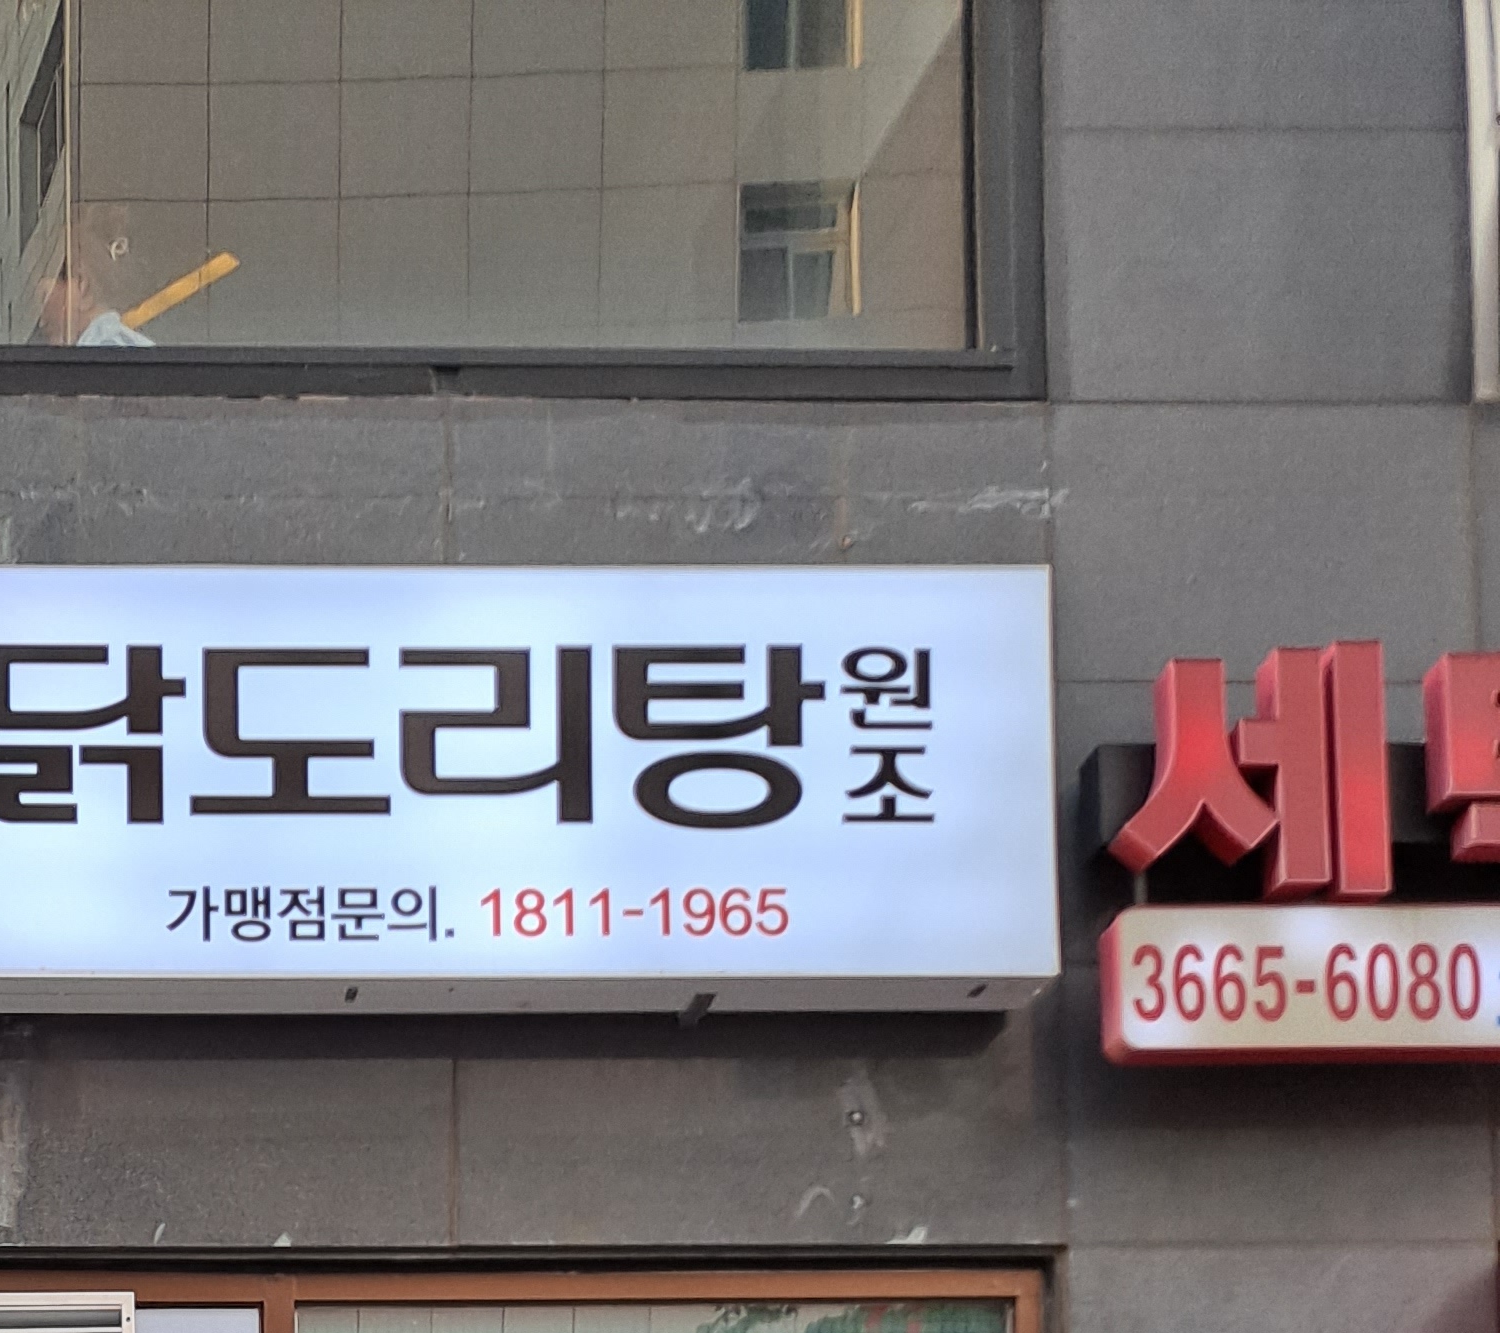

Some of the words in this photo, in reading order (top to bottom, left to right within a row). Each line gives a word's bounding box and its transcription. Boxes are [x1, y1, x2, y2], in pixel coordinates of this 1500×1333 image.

[840, 645, 936, 826] 원조
[479, 888, 790, 938] 1811-1965
[1131, 943, 1482, 1022] 3665-6080
